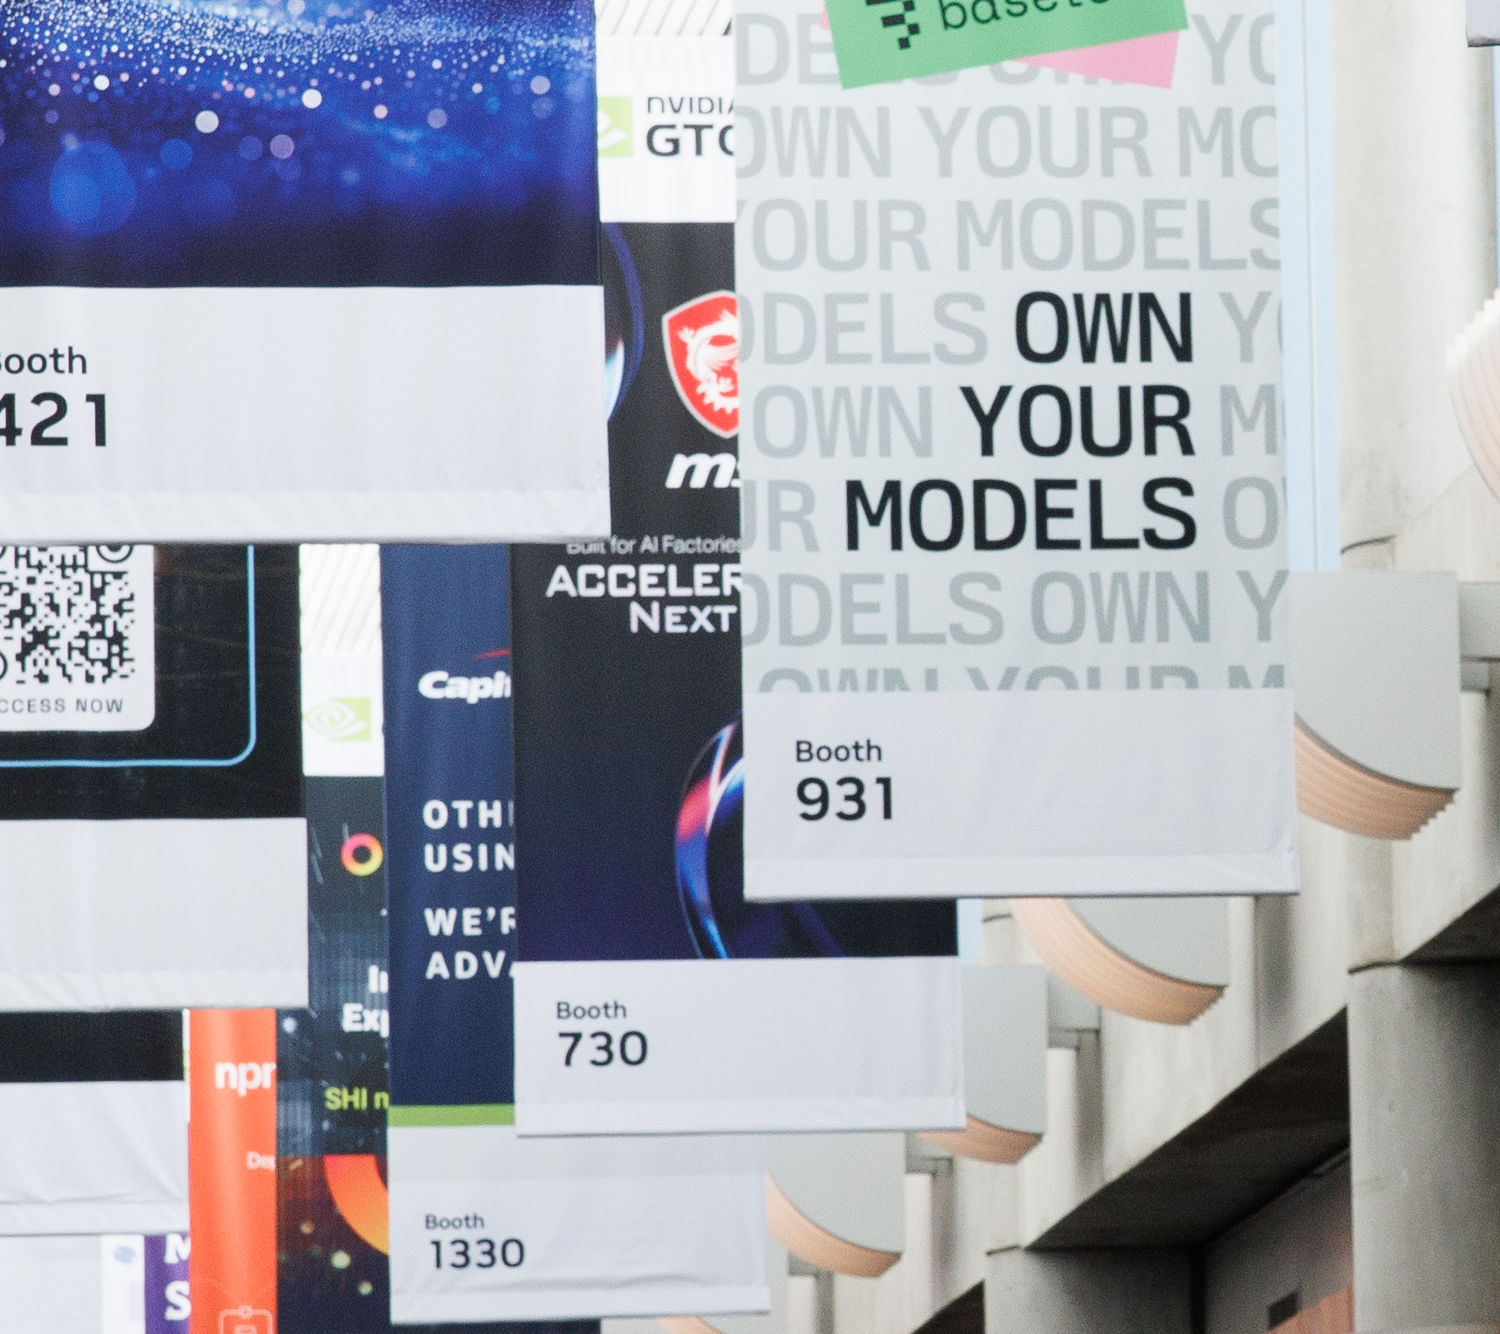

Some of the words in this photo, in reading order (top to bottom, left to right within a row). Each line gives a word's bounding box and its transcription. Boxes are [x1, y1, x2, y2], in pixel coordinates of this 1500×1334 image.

[928, 105, 1152, 178] YOUR
[957, 197, 1282, 271] MODELS
[740, 291, 987, 365] DELS
[1015, 290, 1193, 365] OWN
[752, 385, 932, 459] OWN
[960, 384, 1195, 458] YOUR
[846, 477, 1197, 551] MODELS
[610, 535, 636, 554] for
[639, 535, 660, 554] AI
[1031, 570, 1210, 645] OWN
[75, 697, 125, 714] NOW
[795, 738, 883, 764] Booth
[796, 777, 894, 821] 931
[425, 949, 515, 980] ADV
[556, 999, 628, 1020] Booth
[558, 1030, 649, 1067] 730
[324, 1086, 368, 1111] SHI
[425, 1212, 486, 1231] Booth
[430, 1237, 525, 1270] 1330
